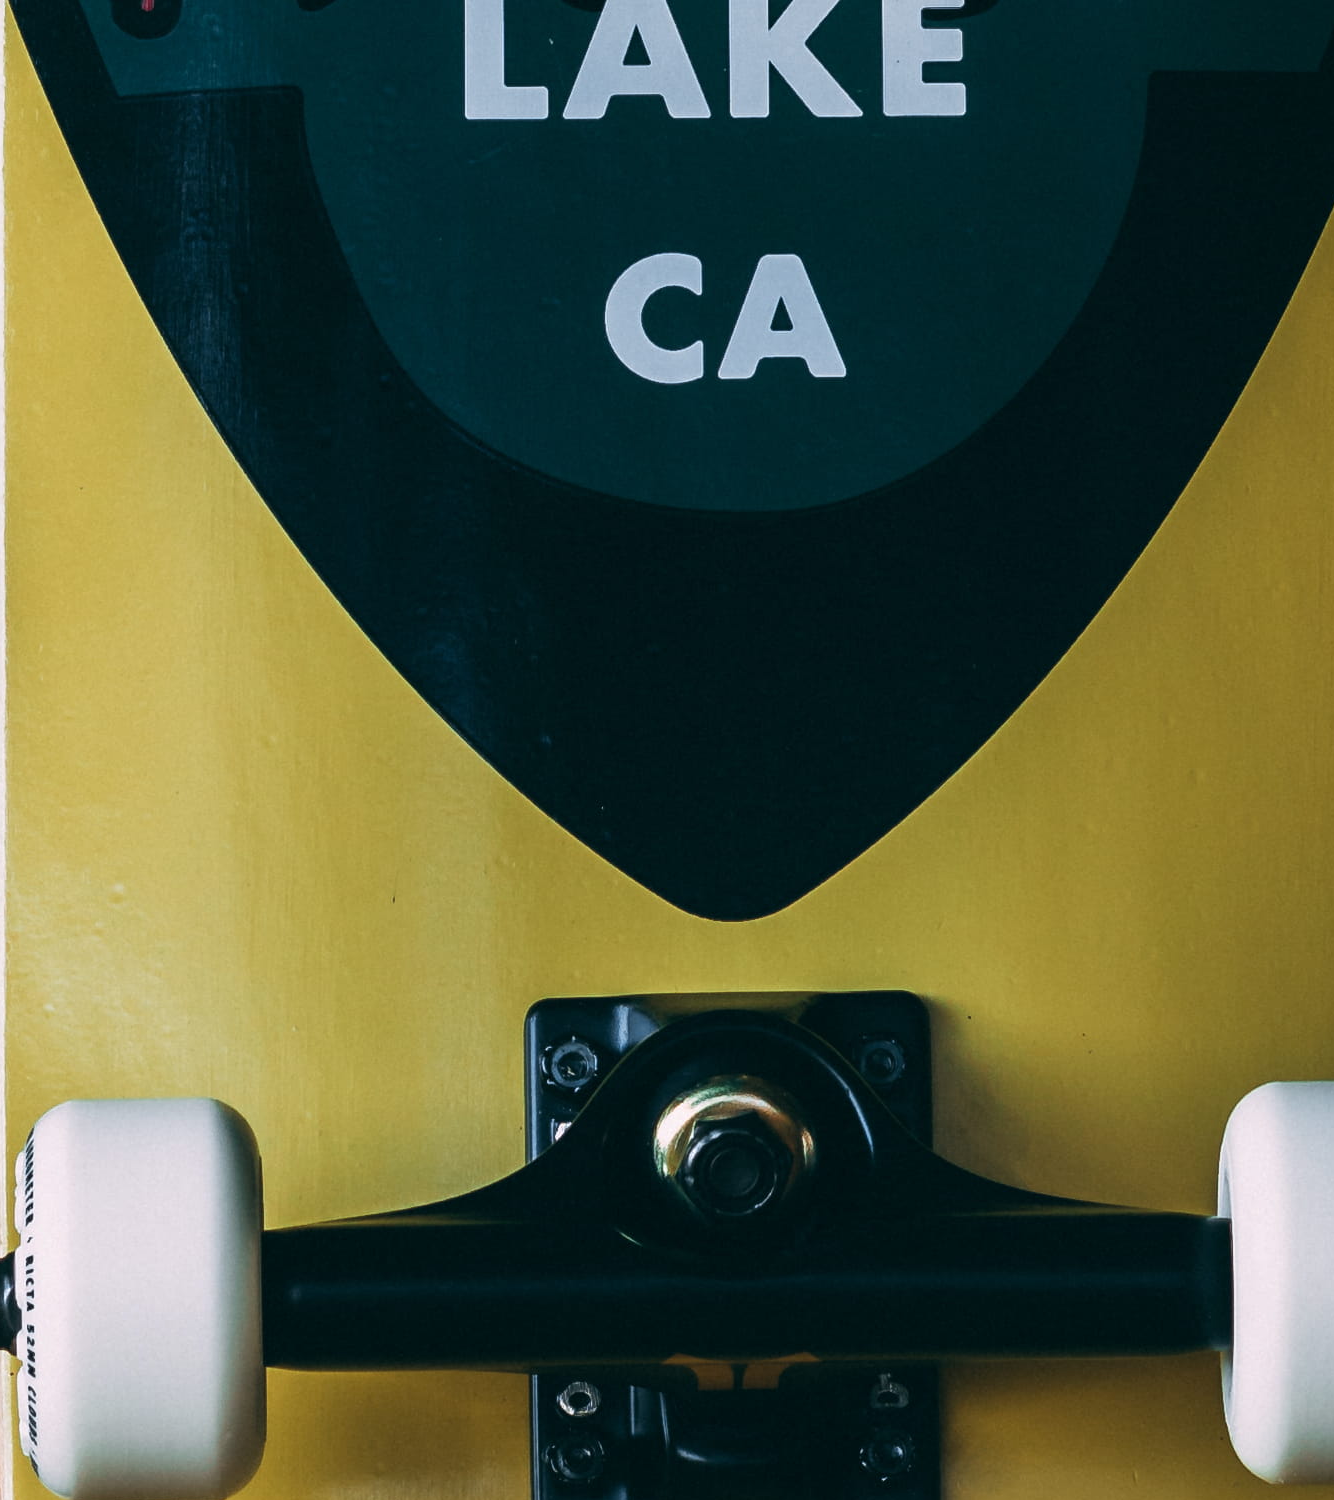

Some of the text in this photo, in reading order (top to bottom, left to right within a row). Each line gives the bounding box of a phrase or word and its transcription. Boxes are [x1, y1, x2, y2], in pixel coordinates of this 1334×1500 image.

[604, 253, 847, 385] CA
[25, 1256, 35, 1312] RICTA
[26, 1324, 36, 1378] 52MM
